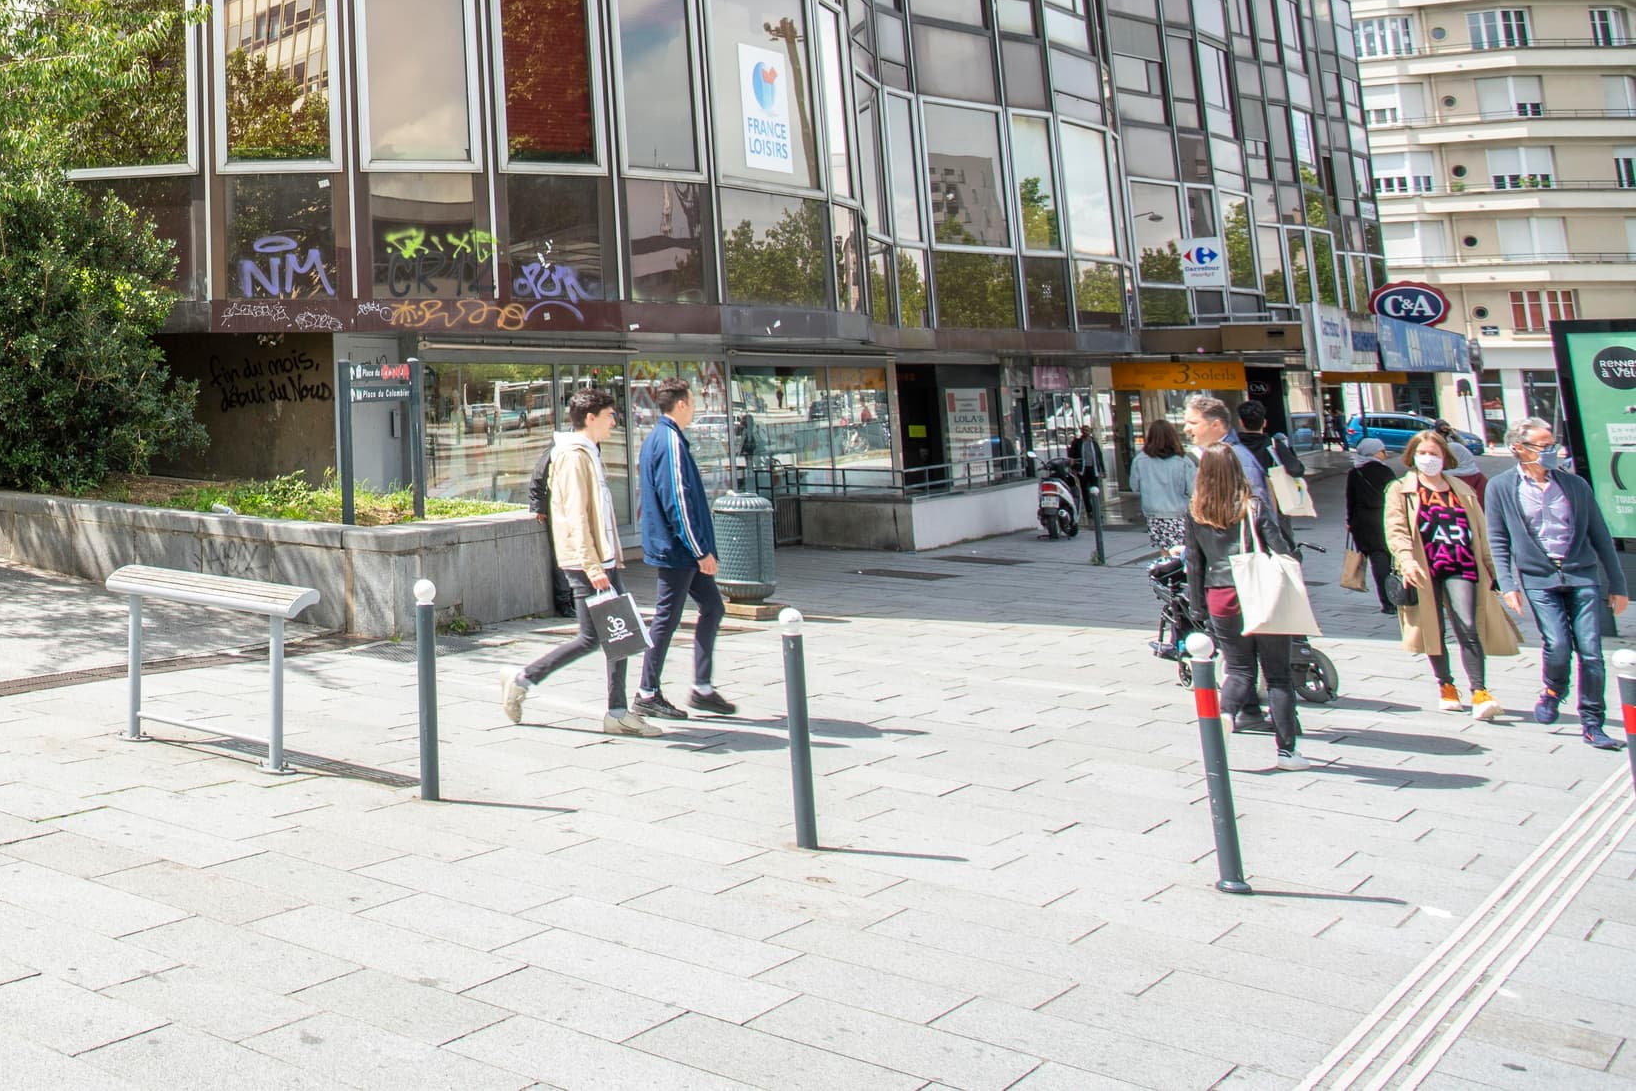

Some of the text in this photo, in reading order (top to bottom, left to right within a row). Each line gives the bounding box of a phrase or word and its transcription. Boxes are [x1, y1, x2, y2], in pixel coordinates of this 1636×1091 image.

[747, 116, 787, 140] FRANCE
[748, 137, 789, 160] LOISIRS
[1383, 294, 1436, 317] C&A
[243, 357, 264, 378] du
[1173, 363, 1191, 384] 3
[1193, 368, 1237, 382] Soleils
[1612, 367, 1636, 378] Vél
[268, 379, 291, 402] du
[362, 389, 410, 398] Place du Colombier
